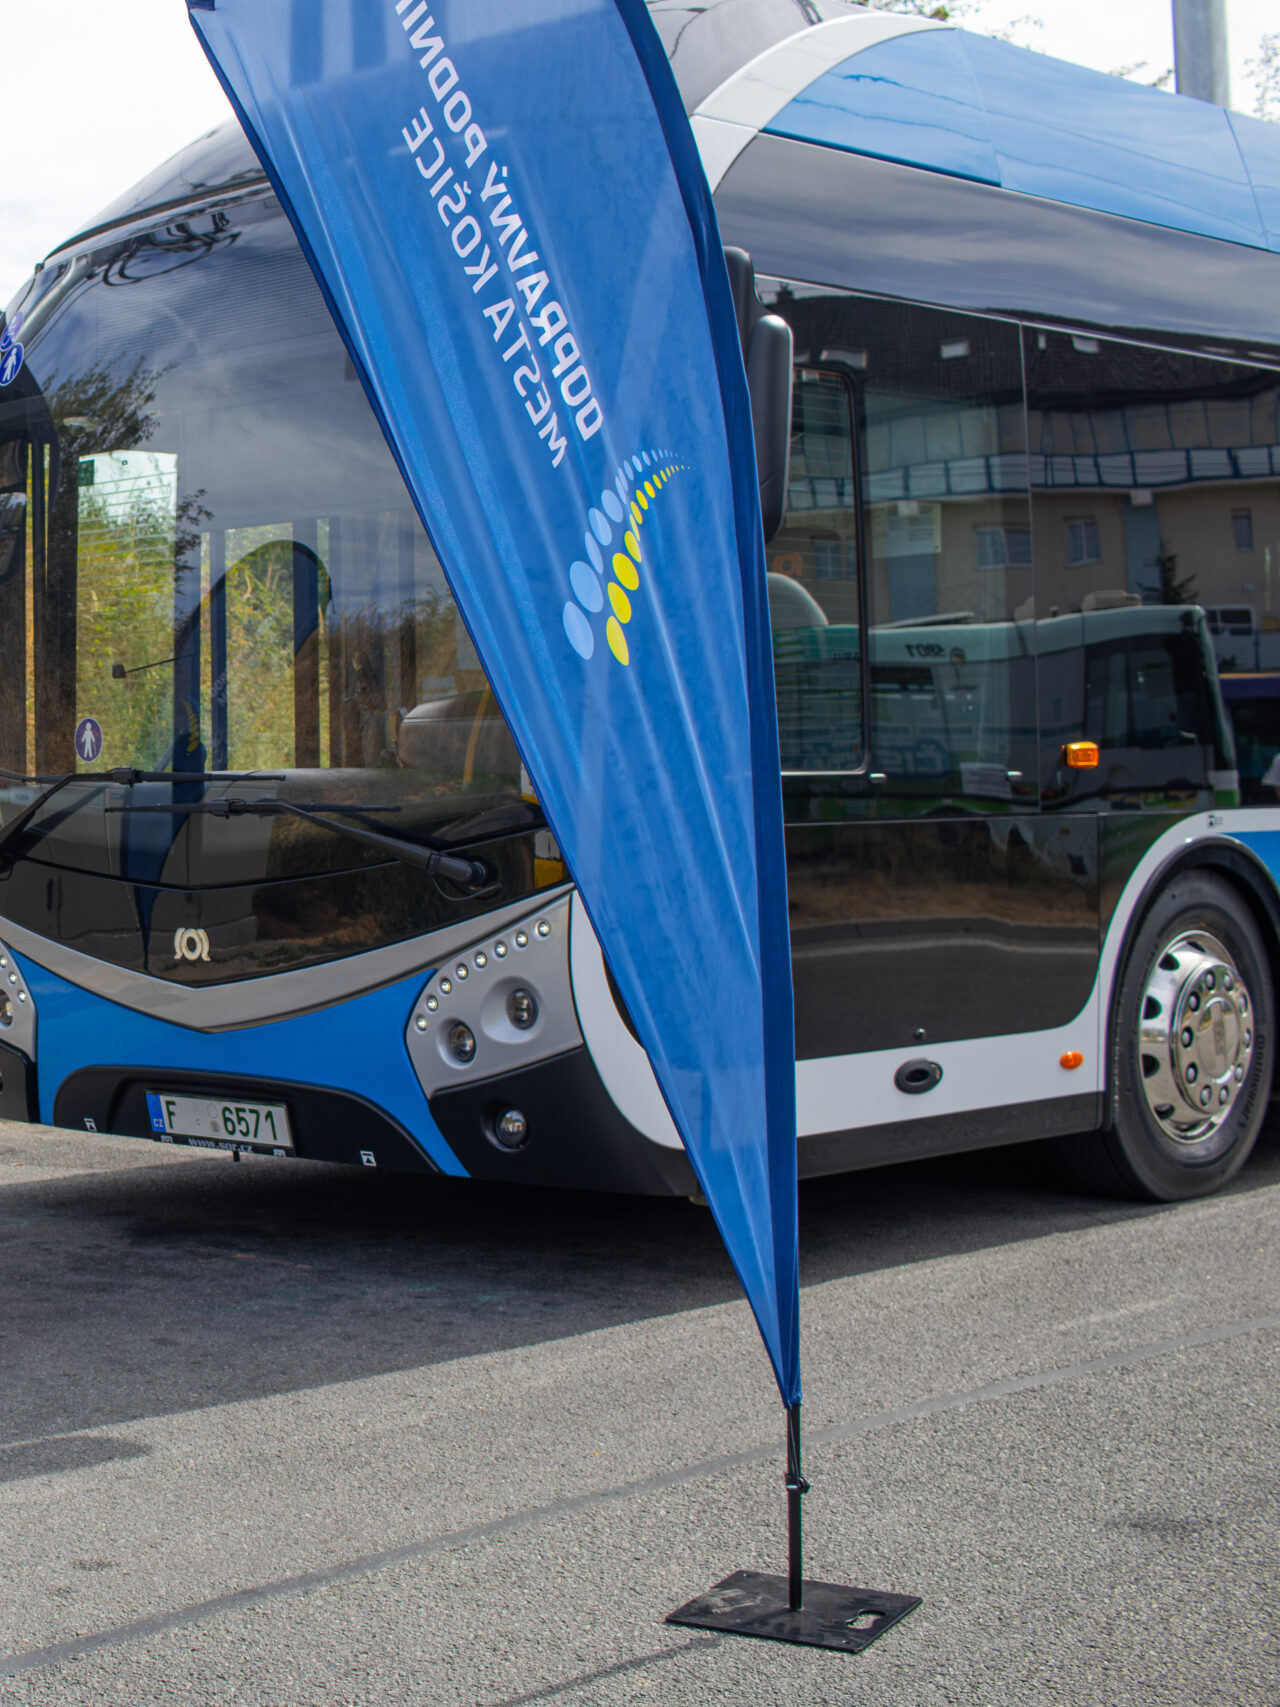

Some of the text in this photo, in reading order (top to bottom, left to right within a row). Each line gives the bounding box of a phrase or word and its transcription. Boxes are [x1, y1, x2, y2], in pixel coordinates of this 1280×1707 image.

[153, 1117, 164, 1128] CZ
[165, 1100, 278, 1141] F 6571
